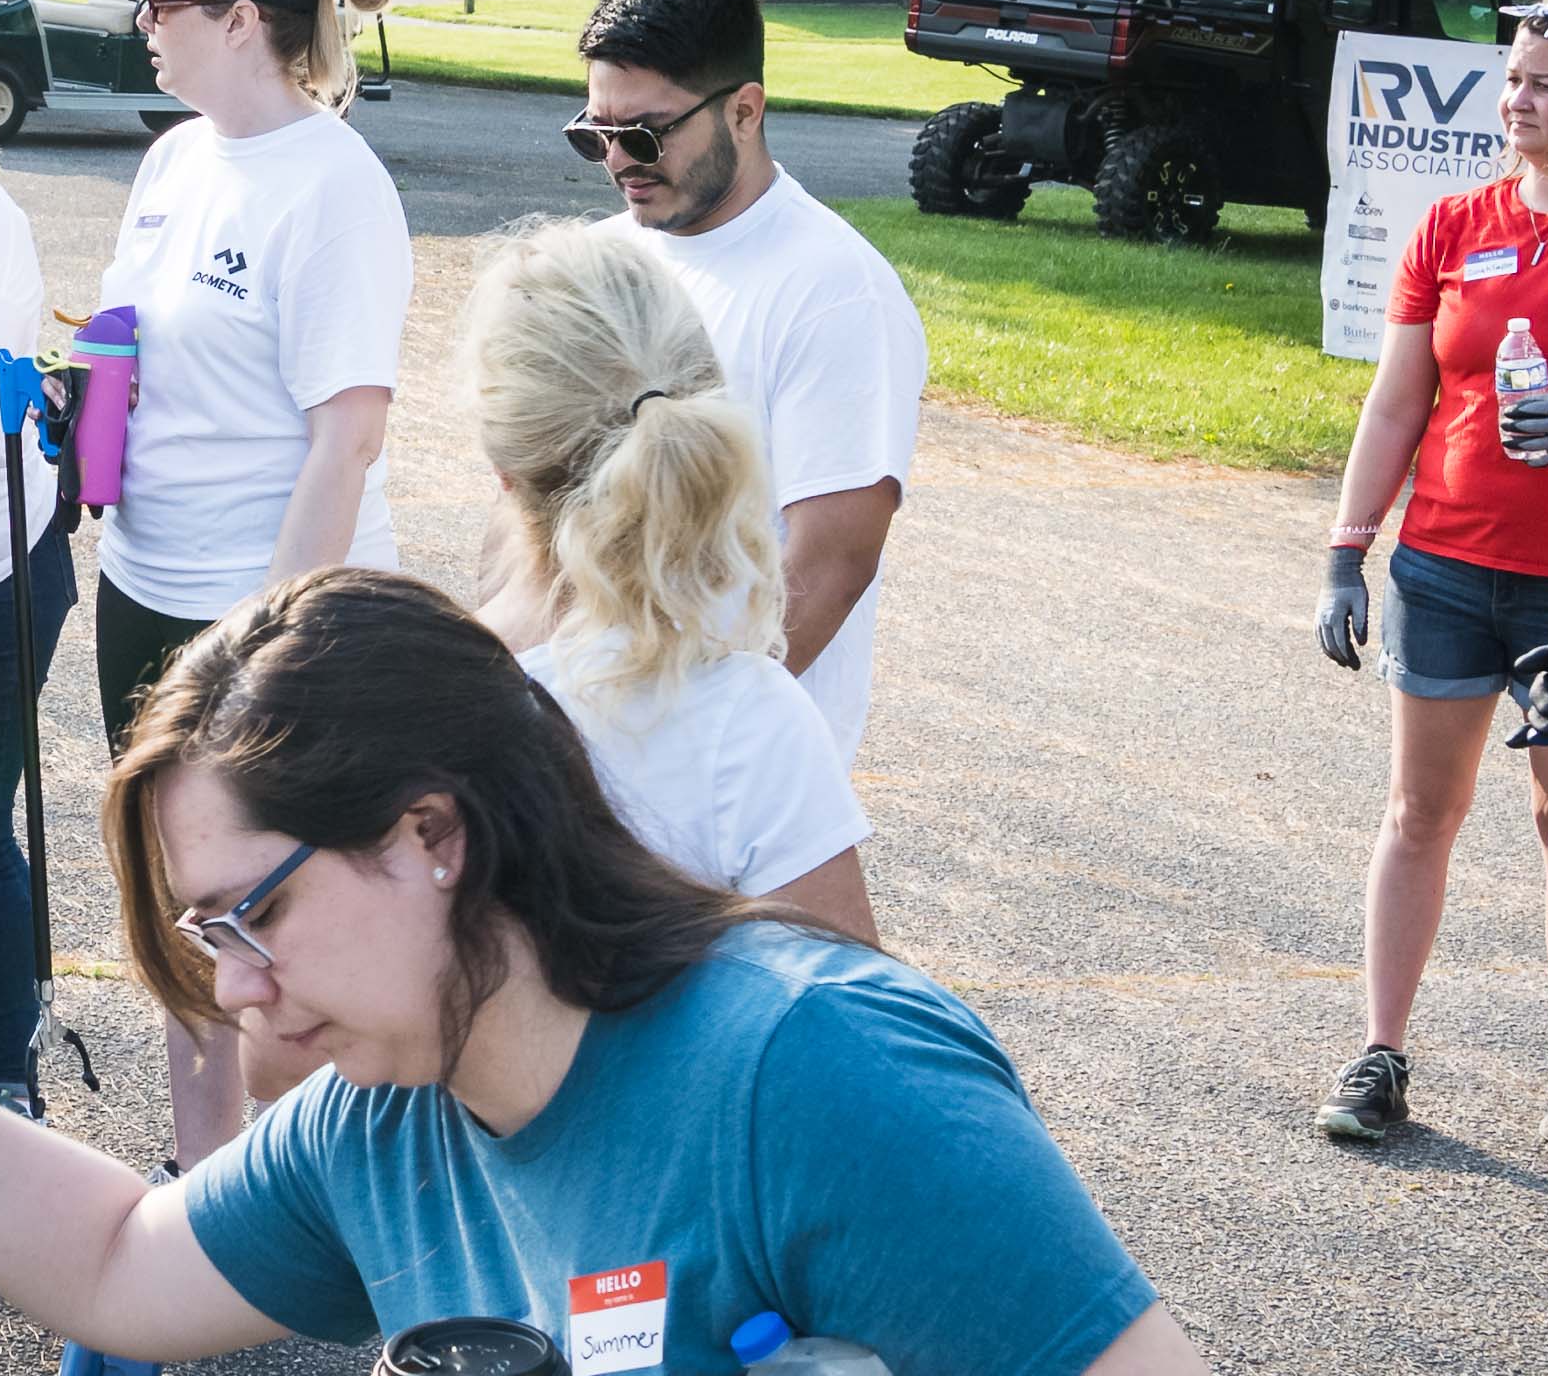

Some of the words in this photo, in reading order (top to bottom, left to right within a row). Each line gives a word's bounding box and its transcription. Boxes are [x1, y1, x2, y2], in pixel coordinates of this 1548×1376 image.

[985, 28, 1039, 45] POLARIS
[1351, 59, 1487, 124] RV
[1349, 121, 1510, 158] INDUSTRY
[596, 1271, 642, 1295] HELLO
[581, 1331, 659, 1360] Summer
